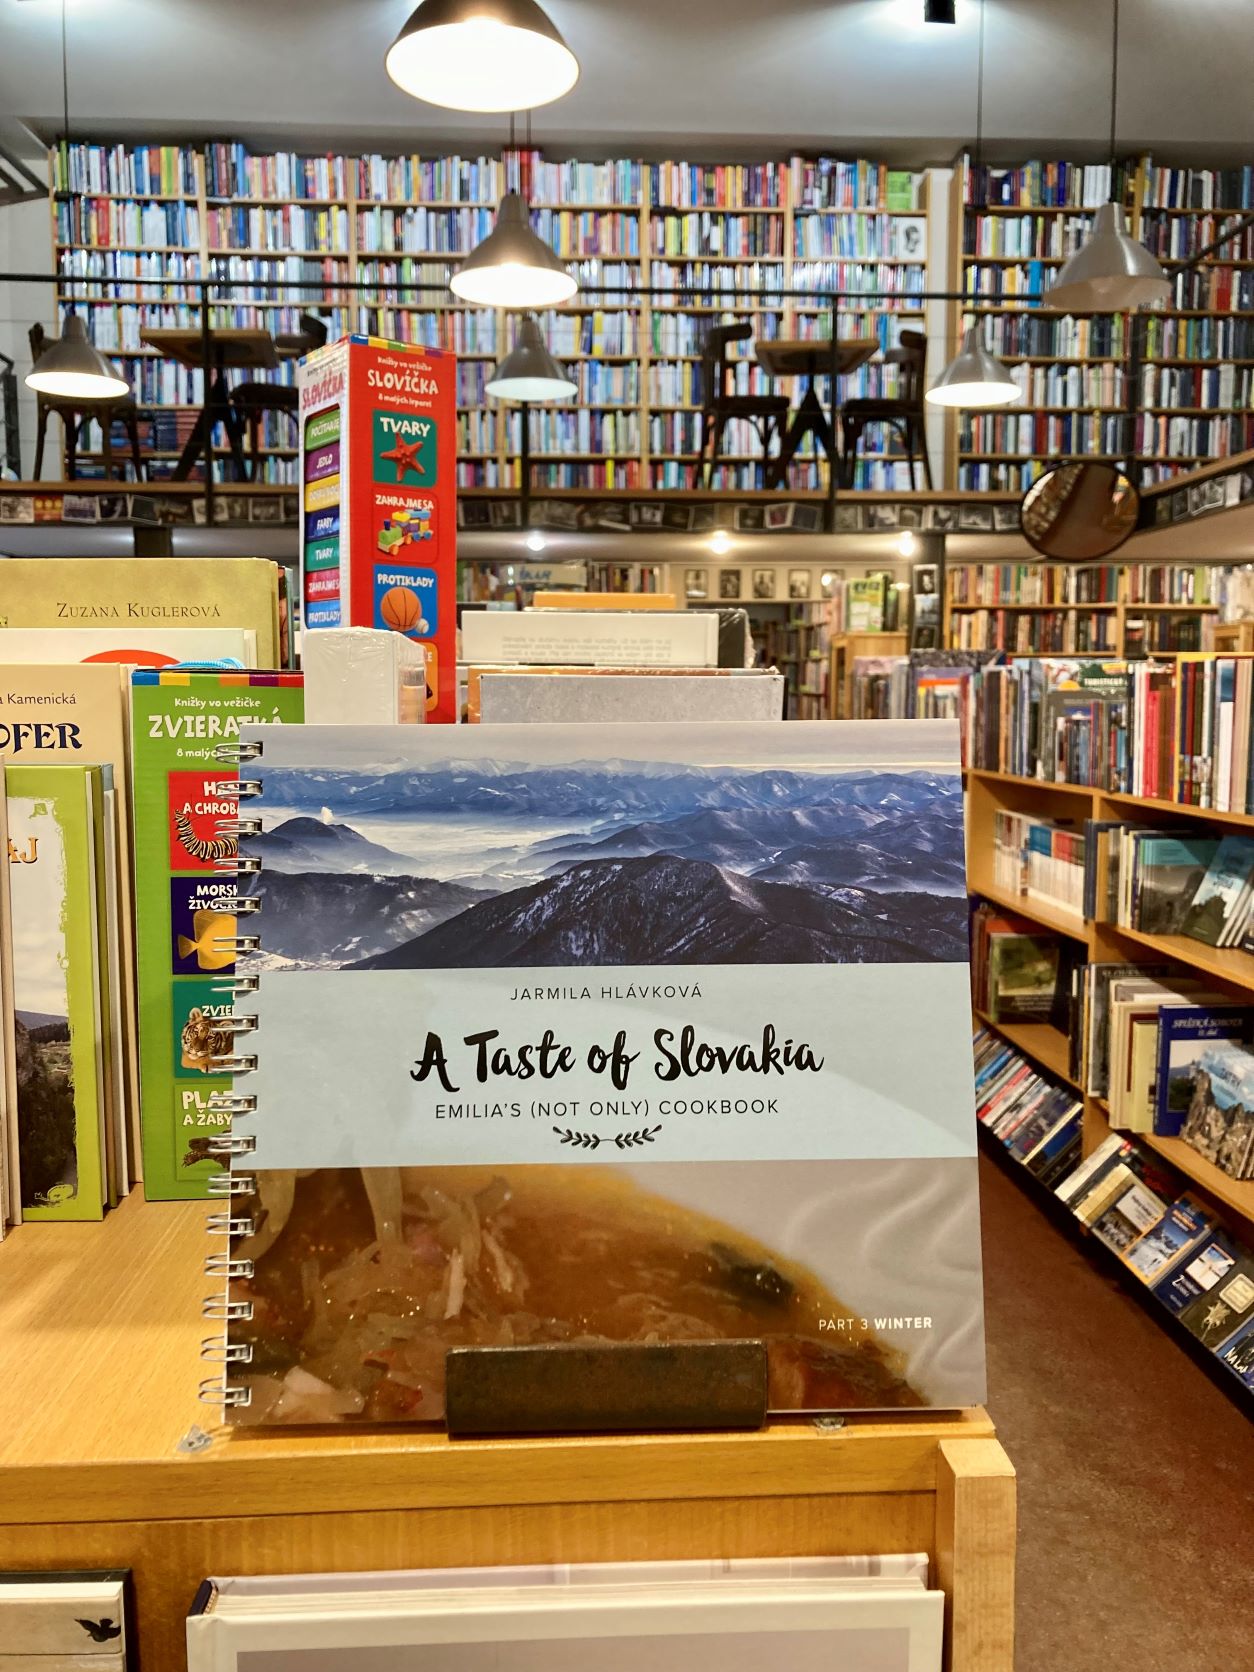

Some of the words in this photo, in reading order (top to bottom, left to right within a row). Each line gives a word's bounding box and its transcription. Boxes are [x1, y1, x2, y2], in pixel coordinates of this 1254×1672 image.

[367, 368, 439, 395] SLOVÍČKA
[380, 416, 431, 438] TVARY
[315, 547, 333, 561] TVARY
[377, 573, 435, 588] PROTIKLADY
[7, 693, 77, 705] Kamenická
[174, 698, 207, 710] Knižky
[223, 697, 261, 708] vežičke
[148, 707, 283, 739] ZVIERA
[176, 748, 183, 757] 8
[185, 748, 226, 760] malýc
[183, 802, 192, 815] A
[195, 802, 239, 815] CHROB
[510, 986, 592, 1001] JARMILA
[600, 982, 703, 999] HLÁVKOVÁ
[202, 1004, 235, 1017] ZVIE
[410, 1031, 460, 1092] A
[463, 1029, 577, 1083] Taste
[587, 1030, 640, 1091] of
[653, 1023, 825, 1081] Slovakia
[530, 1101, 581, 1119] (NOT
[589, 1099, 650, 1118] ONLY)
[658, 1098, 779, 1115] COOKBOOK
[183, 1114, 194, 1126] A
[196, 1109, 233, 1126] ŽABY
[819, 1318, 855, 1331] PART
[860, 1318, 868, 1330] 3
[874, 1316, 933, 1330] WINTER
